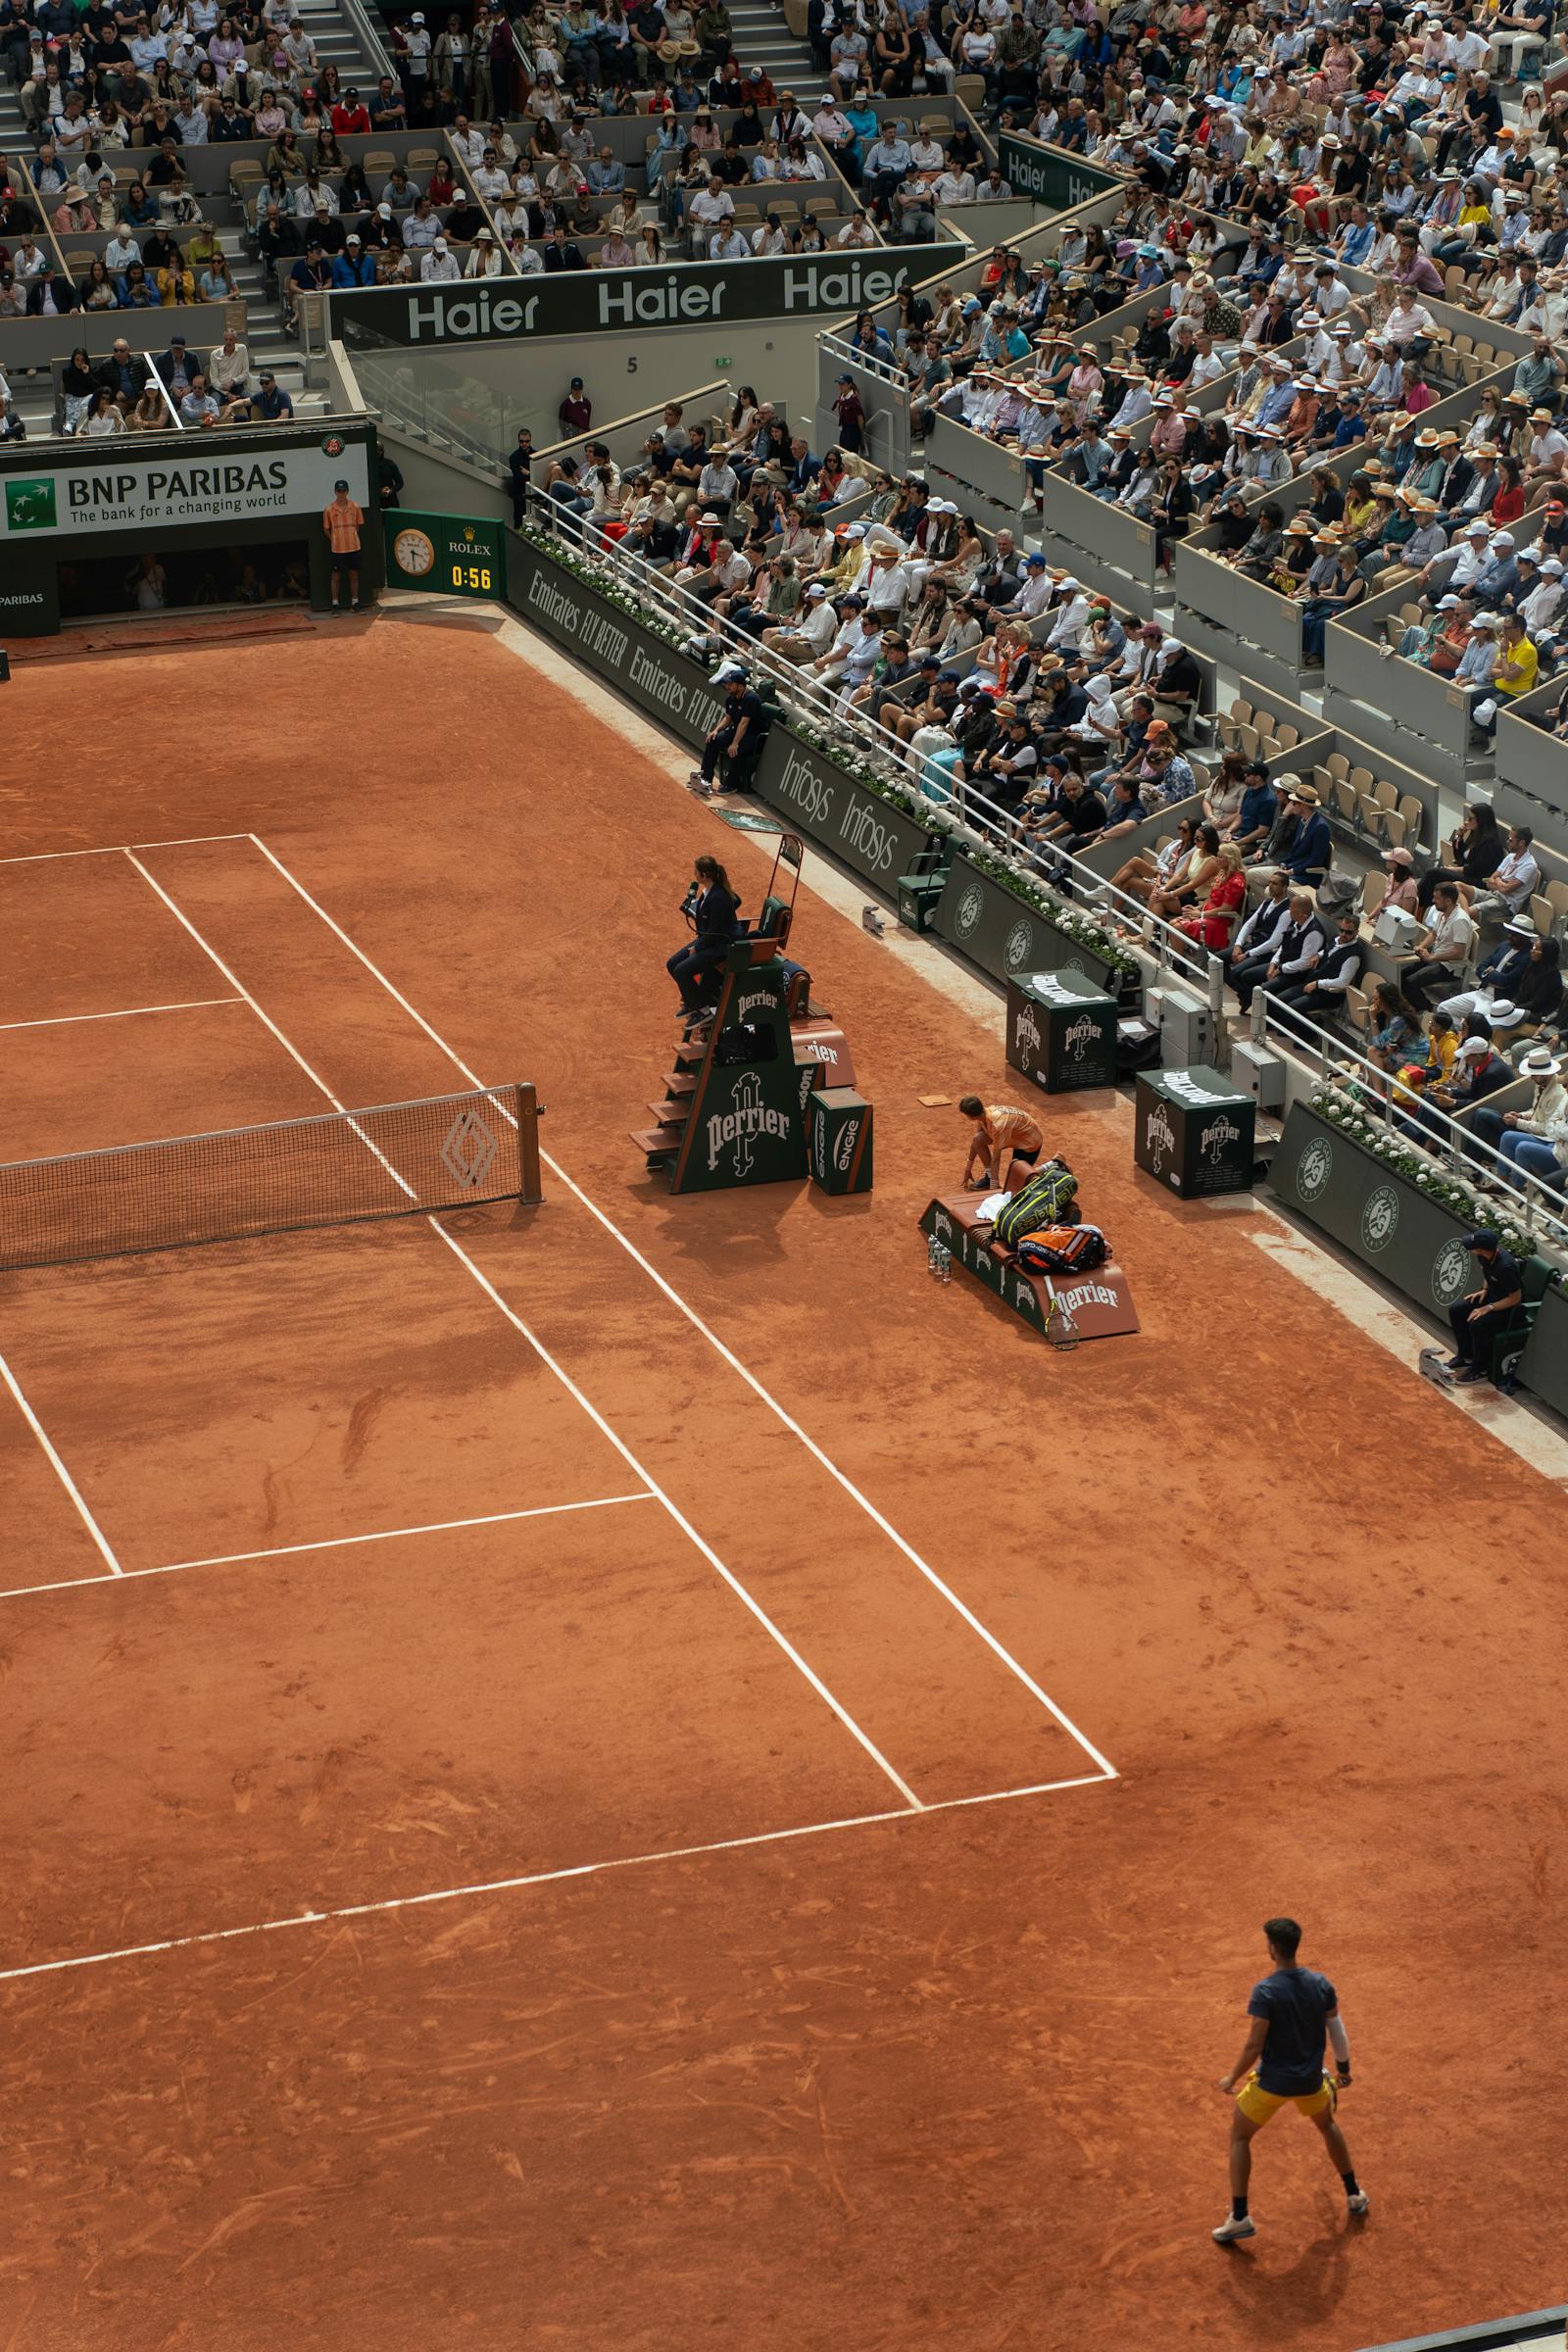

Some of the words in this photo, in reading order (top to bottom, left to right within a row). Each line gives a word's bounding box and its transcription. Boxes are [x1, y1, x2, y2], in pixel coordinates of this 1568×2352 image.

[1008, 152, 1046, 193] Haier
[1069, 175, 1100, 204] Hai
[599, 275, 726, 324] Haier
[784, 262, 907, 309] Haier
[408, 290, 538, 339] Haier
[627, 357, 637, 373] 5
[69, 476, 137, 507] BNP
[147, 462, 287, 501] PARIBAS
[71, 511, 96, 523] The
[102, 506, 135, 520] bank
[139, 505, 160, 520] for
[166, 506, 173, 515] a
[178, 499, 242, 514] changing
[246, 493, 286, 508] world
[449, 542, 492, 556] ROLEX
[452, 565, 491, 590] 0:56
[528, 568, 580, 632] Emirates
[579, 608, 600, 645] FLY
[593, 619, 629, 668] BETTER
[629, 645, 687, 712] Emirates
[685, 688, 710, 726] FLY
[701, 700, 726, 735] BET
[779, 749, 834, 823] Infosys
[839, 793, 899, 870] Infosys
